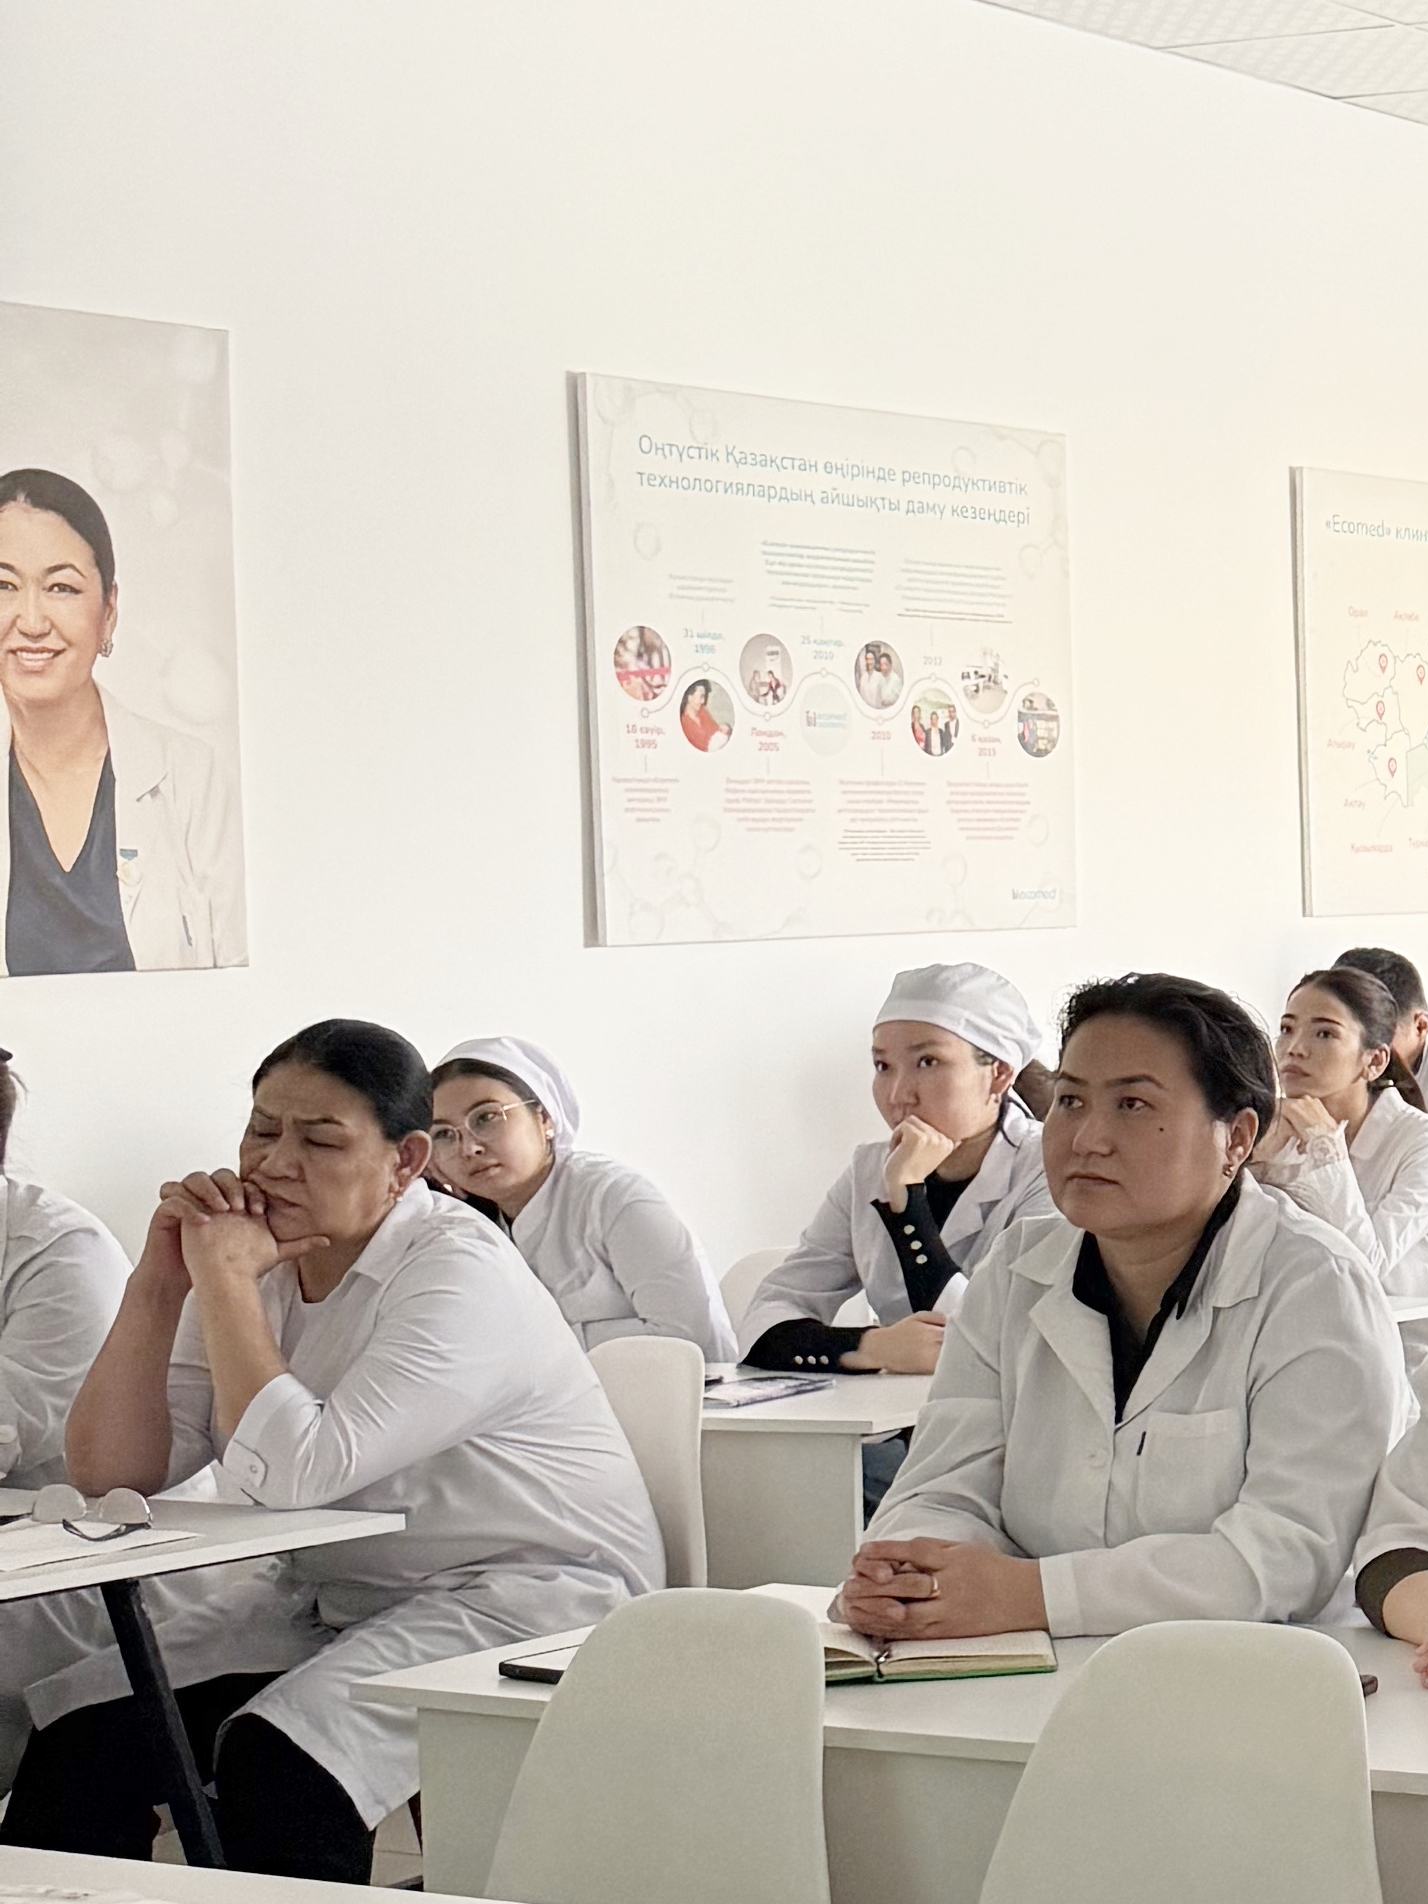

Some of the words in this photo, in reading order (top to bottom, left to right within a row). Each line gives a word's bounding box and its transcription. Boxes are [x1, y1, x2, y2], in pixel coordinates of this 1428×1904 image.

[638, 433, 720, 463] Оңтүстік
[724, 443, 818, 473] Қазақстан
[823, 457, 896, 482] өңірінде
[901, 467, 1027, 495] репродуктивтік
[635, 470, 815, 505] технологиялардың
[820, 486, 900, 513] айшықты
[905, 499, 946, 520] даму
[950, 504, 1030, 527] кезеңдері
